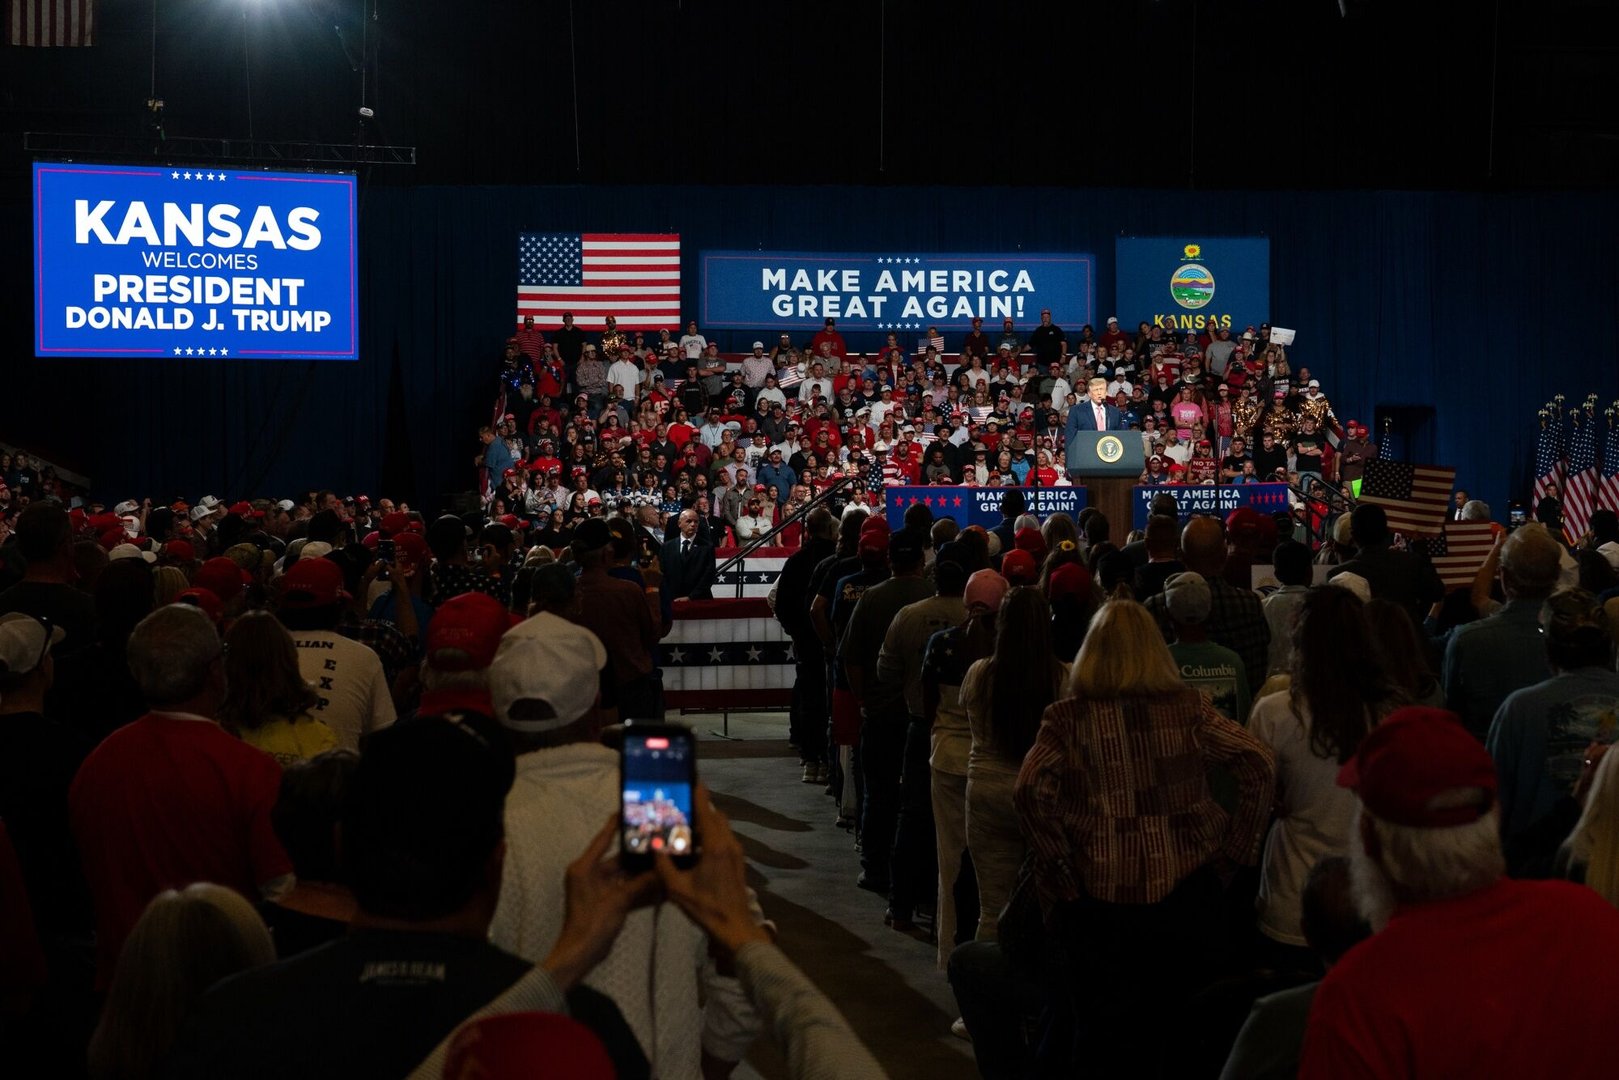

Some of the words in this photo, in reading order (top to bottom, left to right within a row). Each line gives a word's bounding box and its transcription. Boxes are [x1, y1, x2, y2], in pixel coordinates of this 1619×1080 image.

[75, 199, 322, 251] KANSAS
[142, 251, 258, 271] WELCOMES
[94, 274, 305, 306] PRESIDENT
[762, 268, 861, 291] MAKE
[874, 269, 1036, 292] AMERICA
[771, 294, 887, 318] GREAT
[900, 295, 1025, 318] AGAIN!
[65, 306, 194, 330] DONALD
[201, 308, 225, 331] J.
[231, 308, 332, 332] TRUMP
[1154, 314, 1232, 329] KANSAS
[976, 491, 1004, 501] MAK
[1182, 489, 1241, 499] AMERICA
[1027, 501, 1075, 511] AGAIN!
[296, 640, 335, 649] LIAN
